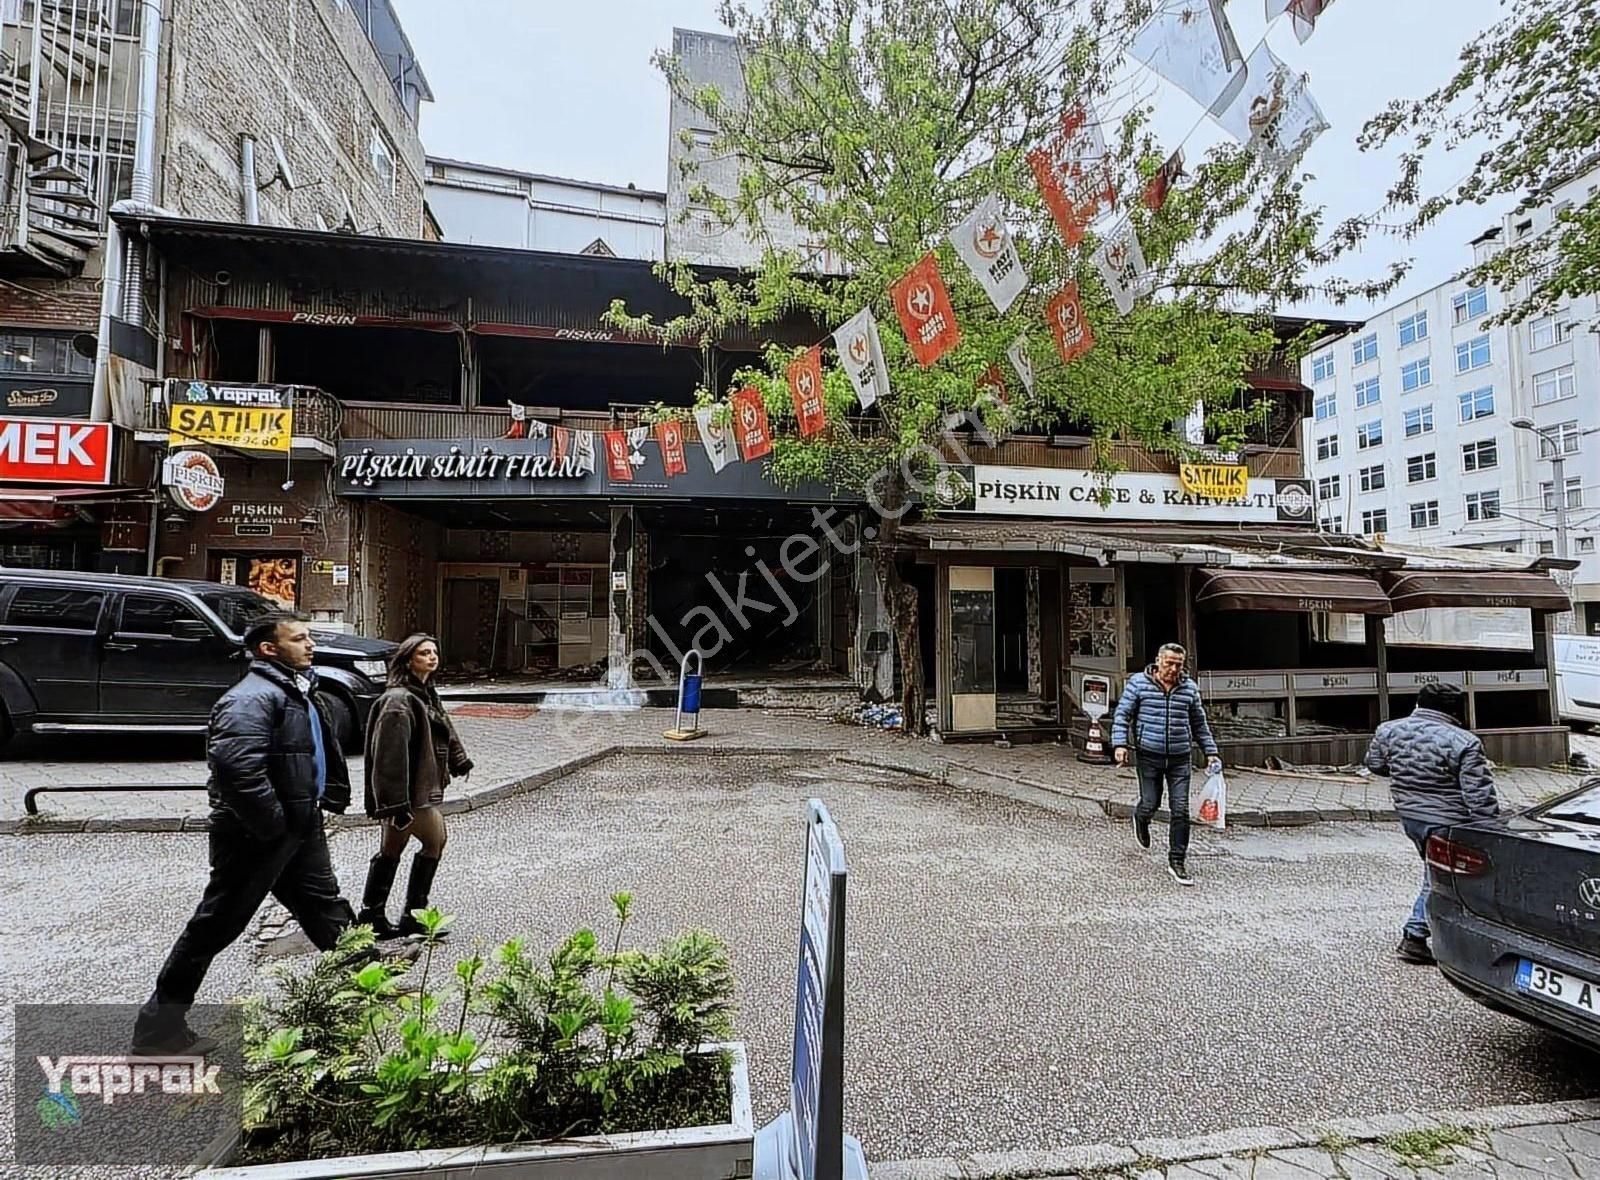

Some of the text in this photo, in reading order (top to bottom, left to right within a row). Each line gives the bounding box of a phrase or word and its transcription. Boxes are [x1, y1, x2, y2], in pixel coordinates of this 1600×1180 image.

[210, 386, 282, 405] Yaprak
[179, 409, 286, 434] SATILIK
[431, 445, 502, 477] SİMİT
[1184, 467, 1243, 485] SATILIK
[979, 479, 1061, 504] PİŞKİN
[1139, 490, 1157, 505] &
[1532, 966, 1600, 1009] 35 A
